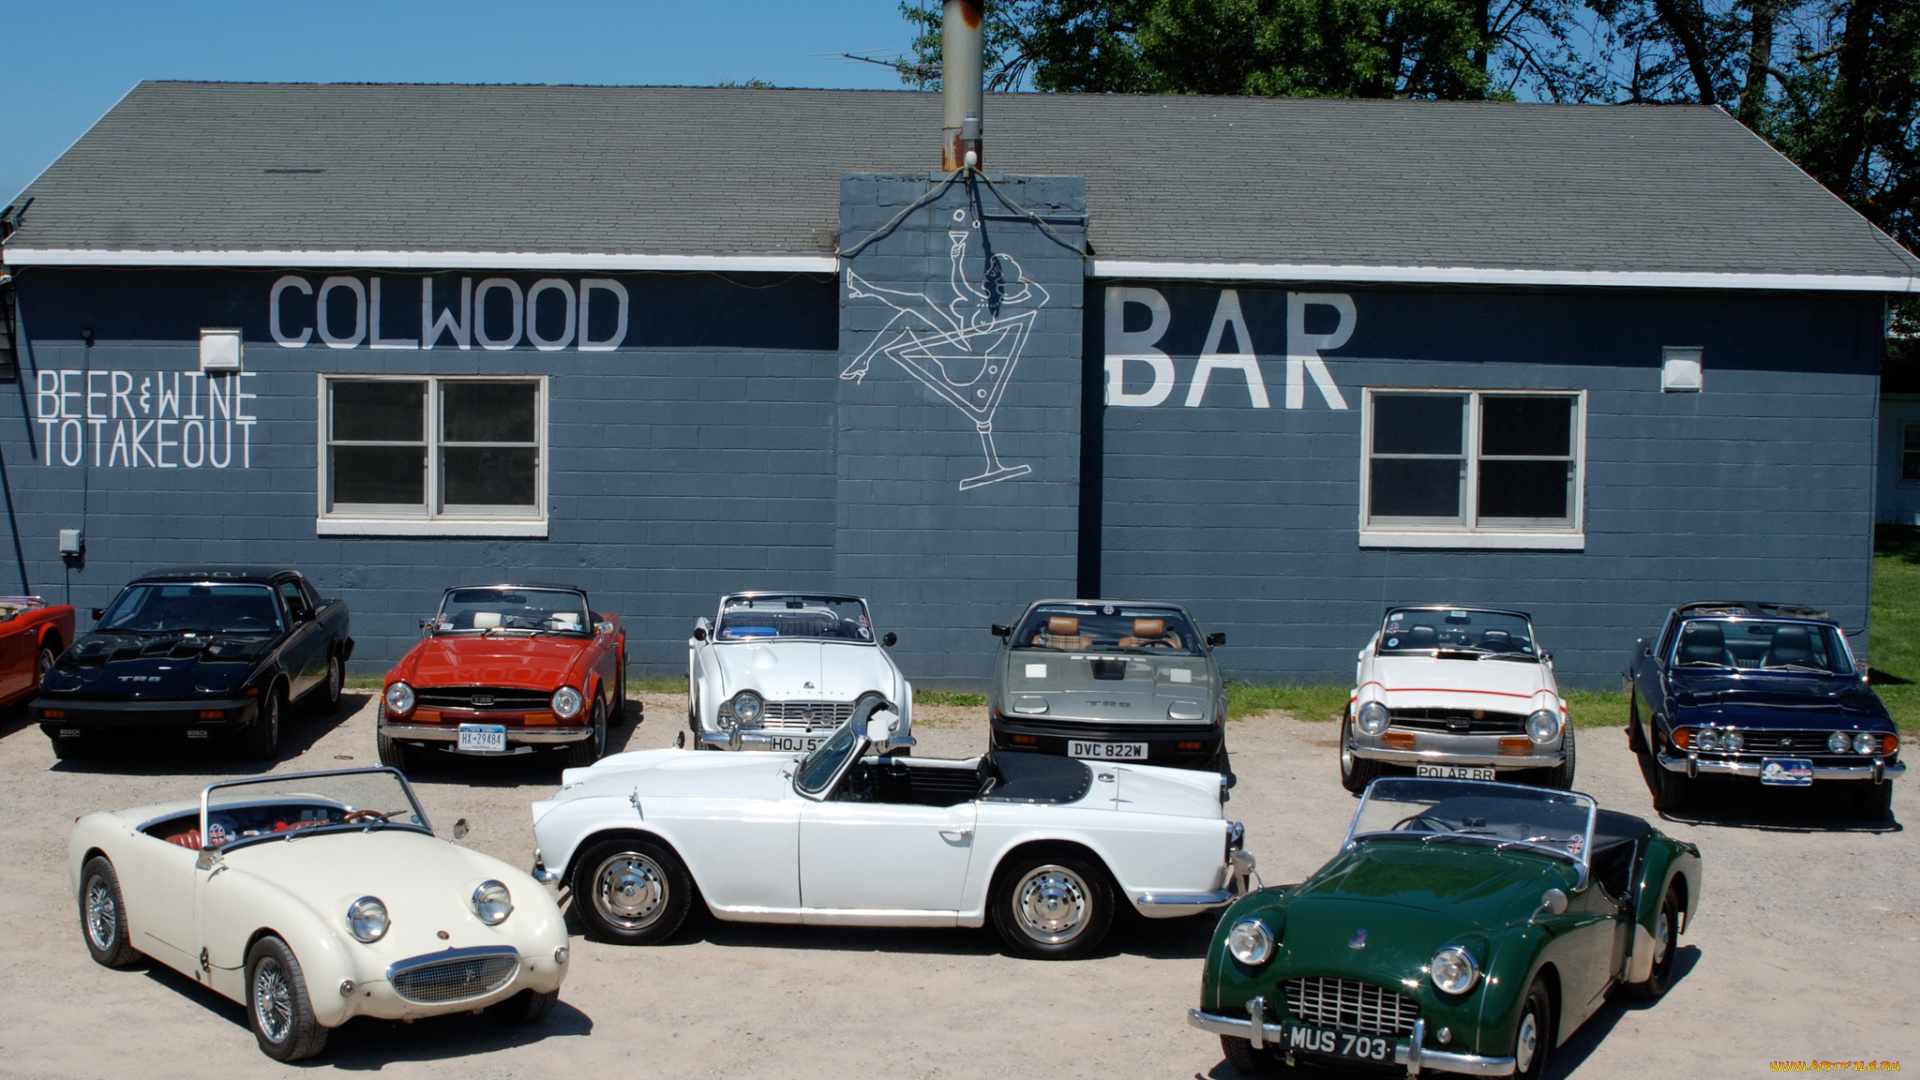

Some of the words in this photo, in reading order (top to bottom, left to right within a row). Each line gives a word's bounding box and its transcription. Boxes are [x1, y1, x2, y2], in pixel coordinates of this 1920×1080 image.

[1103, 286, 1358, 410] BAR
[773, 738, 803, 751] HOJ
[1074, 743, 1101, 756] DVC
[1105, 744, 1142, 757] 822W
[1418, 766, 1468, 779] POLAR
[1290, 1026, 1336, 1053] MUS
[1341, 1033, 1386, 1060] 703
